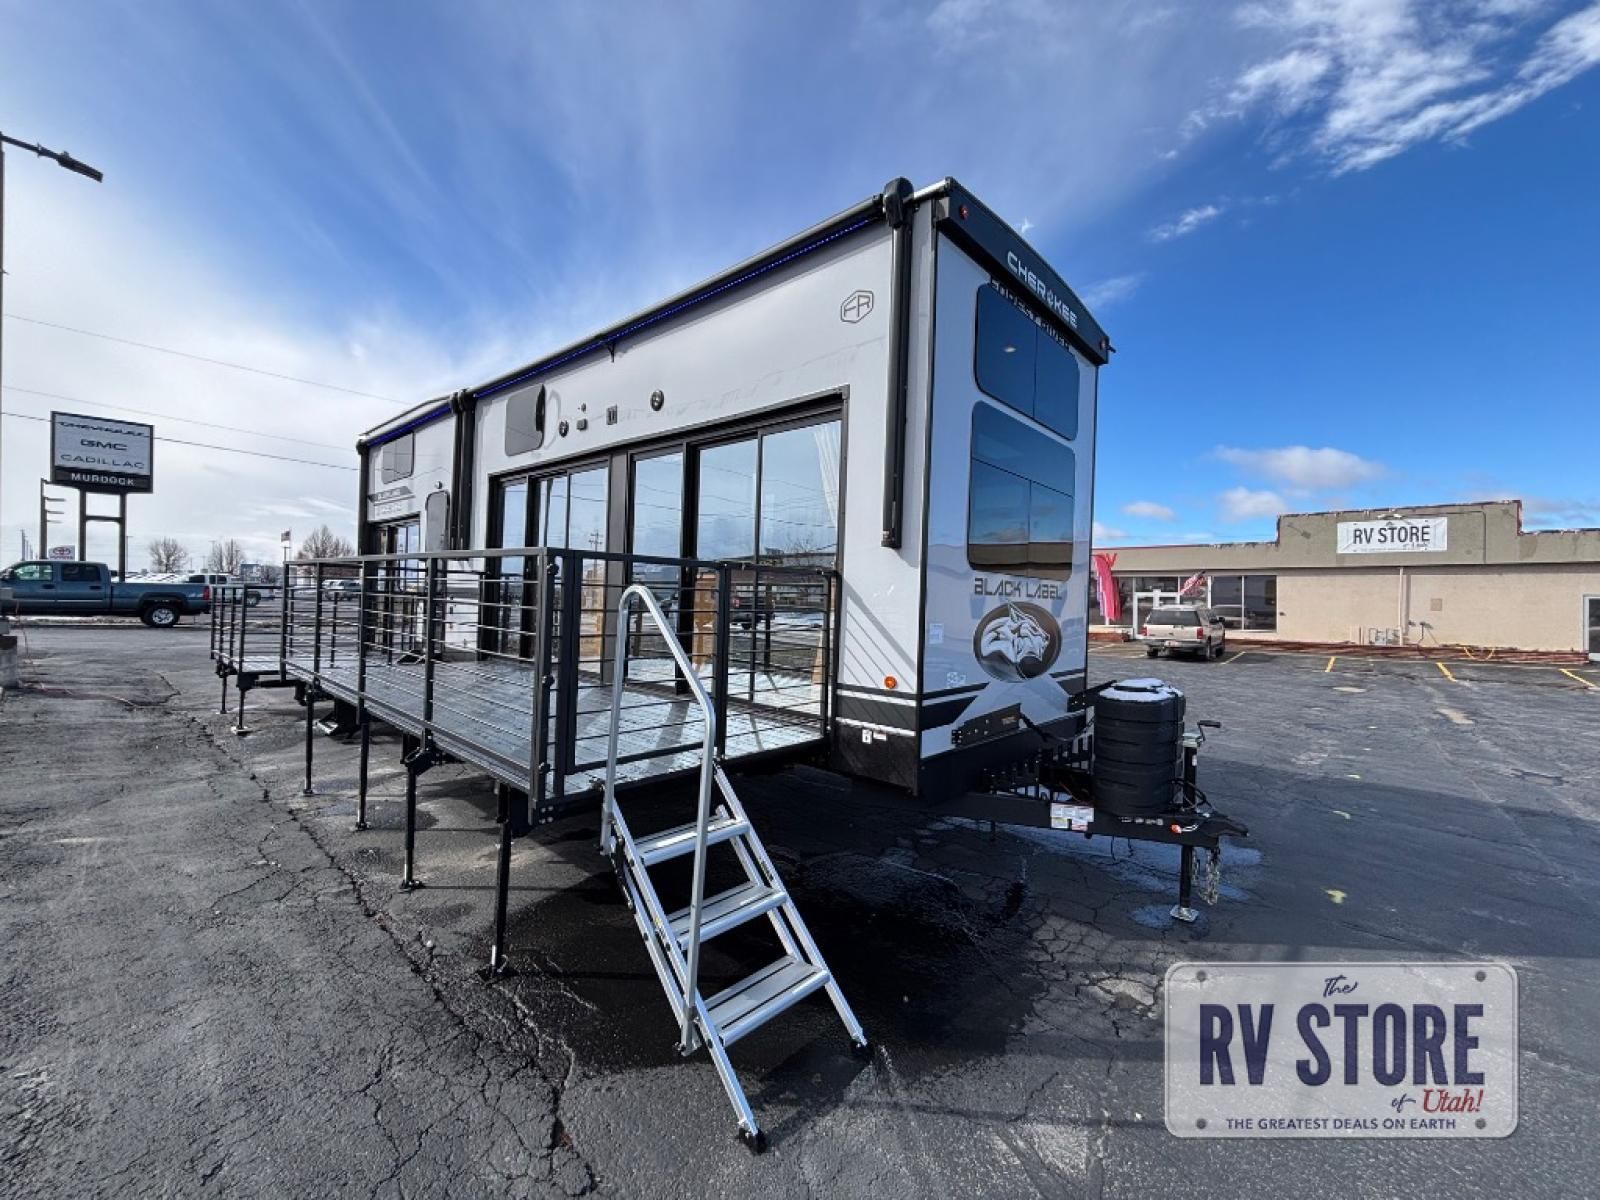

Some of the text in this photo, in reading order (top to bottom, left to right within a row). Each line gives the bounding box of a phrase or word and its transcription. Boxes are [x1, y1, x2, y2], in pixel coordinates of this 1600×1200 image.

[80, 438, 128, 451] GMC
[60, 454, 145, 469] CADILLAC
[71, 472, 135, 486] MURDOCK
[1352, 525, 1431, 544] RV STORE
[974, 577, 1063, 600] BLACK LABEL
